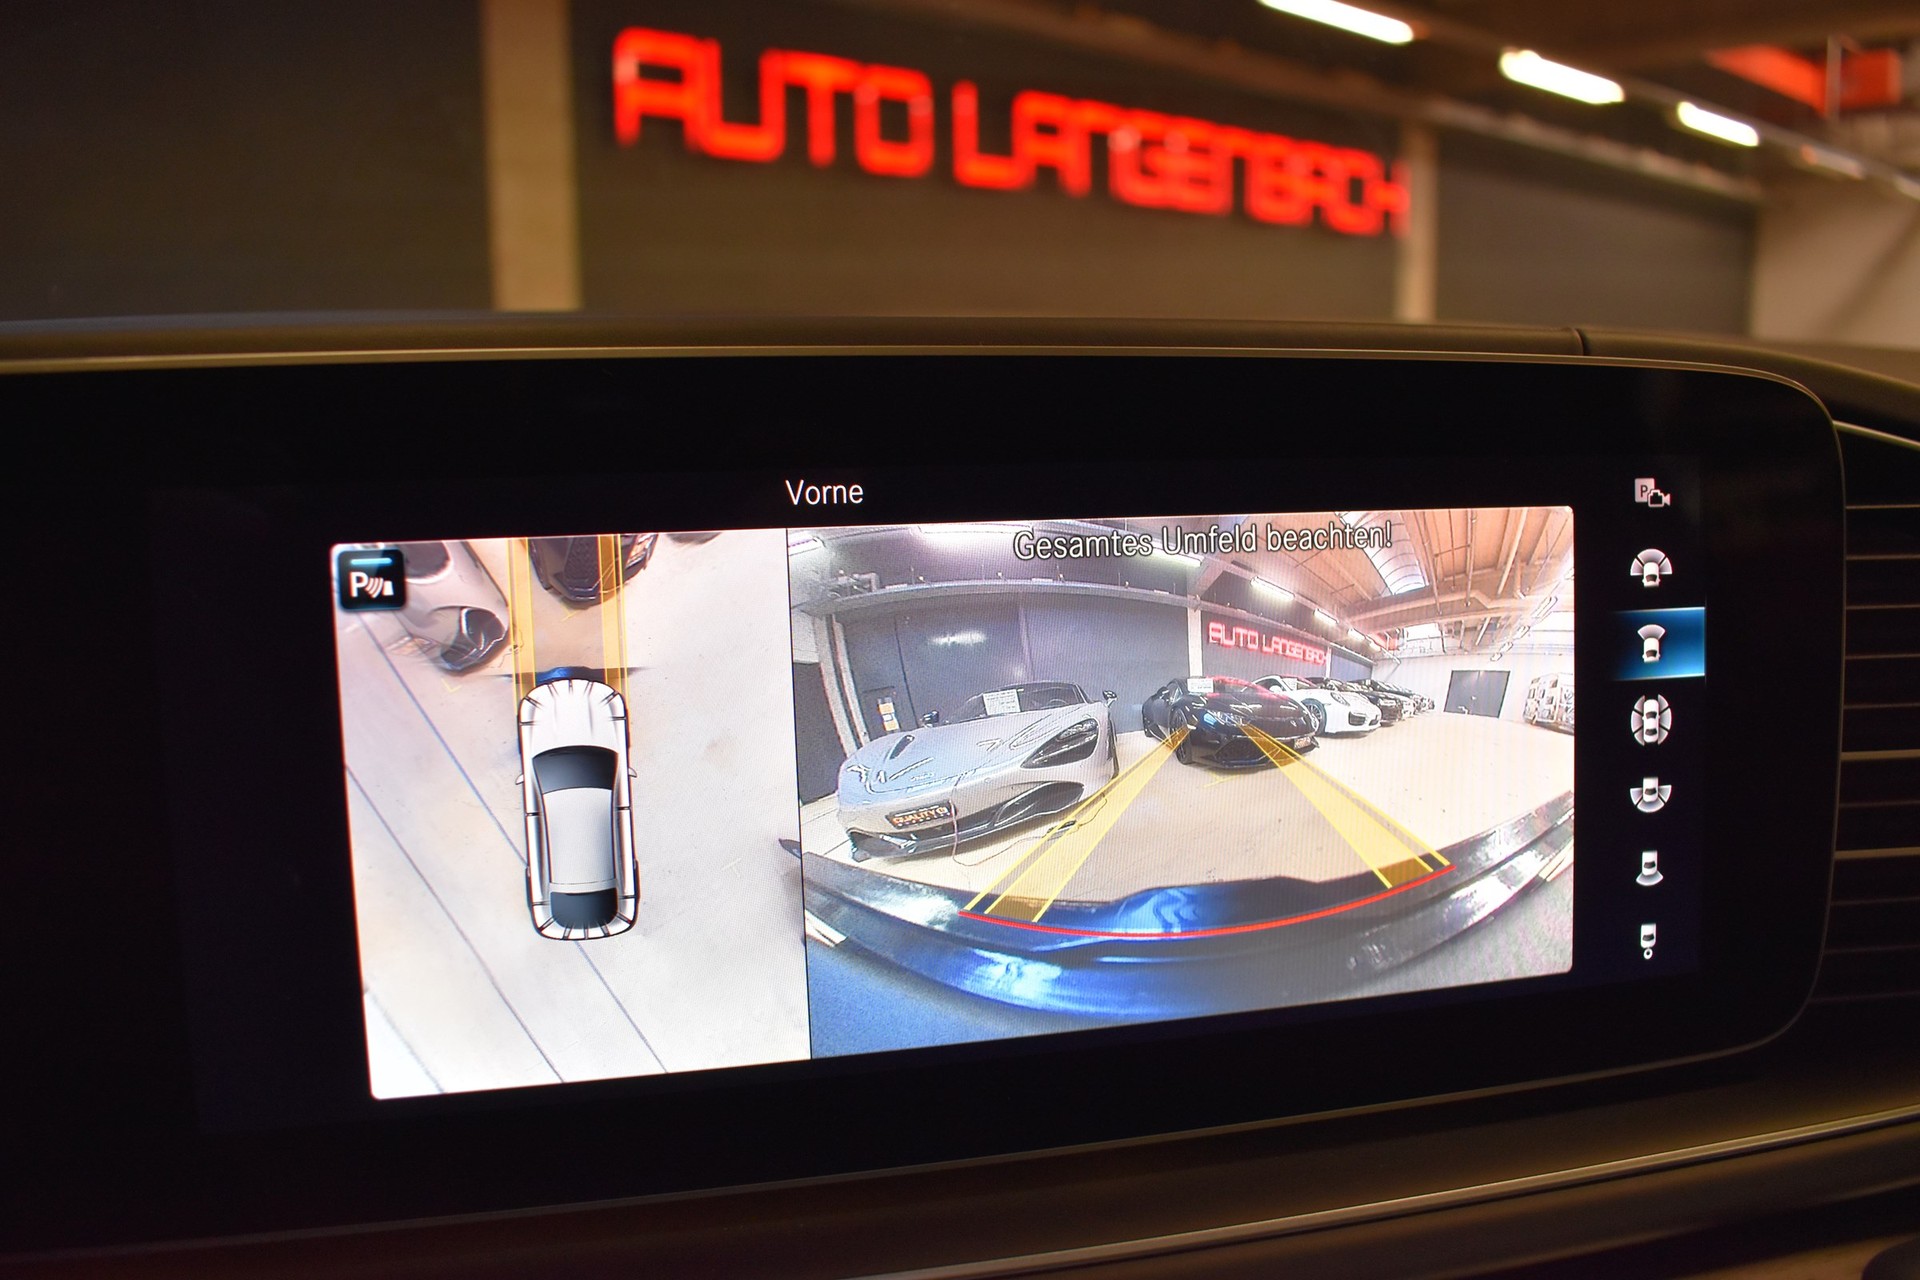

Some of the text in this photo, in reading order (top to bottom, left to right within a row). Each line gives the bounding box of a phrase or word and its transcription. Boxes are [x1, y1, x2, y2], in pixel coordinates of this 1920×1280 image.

[614, 27, 1412, 237] AUTO LANGENBACH
[785, 480, 864, 506] Vorne
[1013, 520, 1393, 561] Gesamtes Umfeld beachten!
[1208, 621, 1259, 650] AUTO
